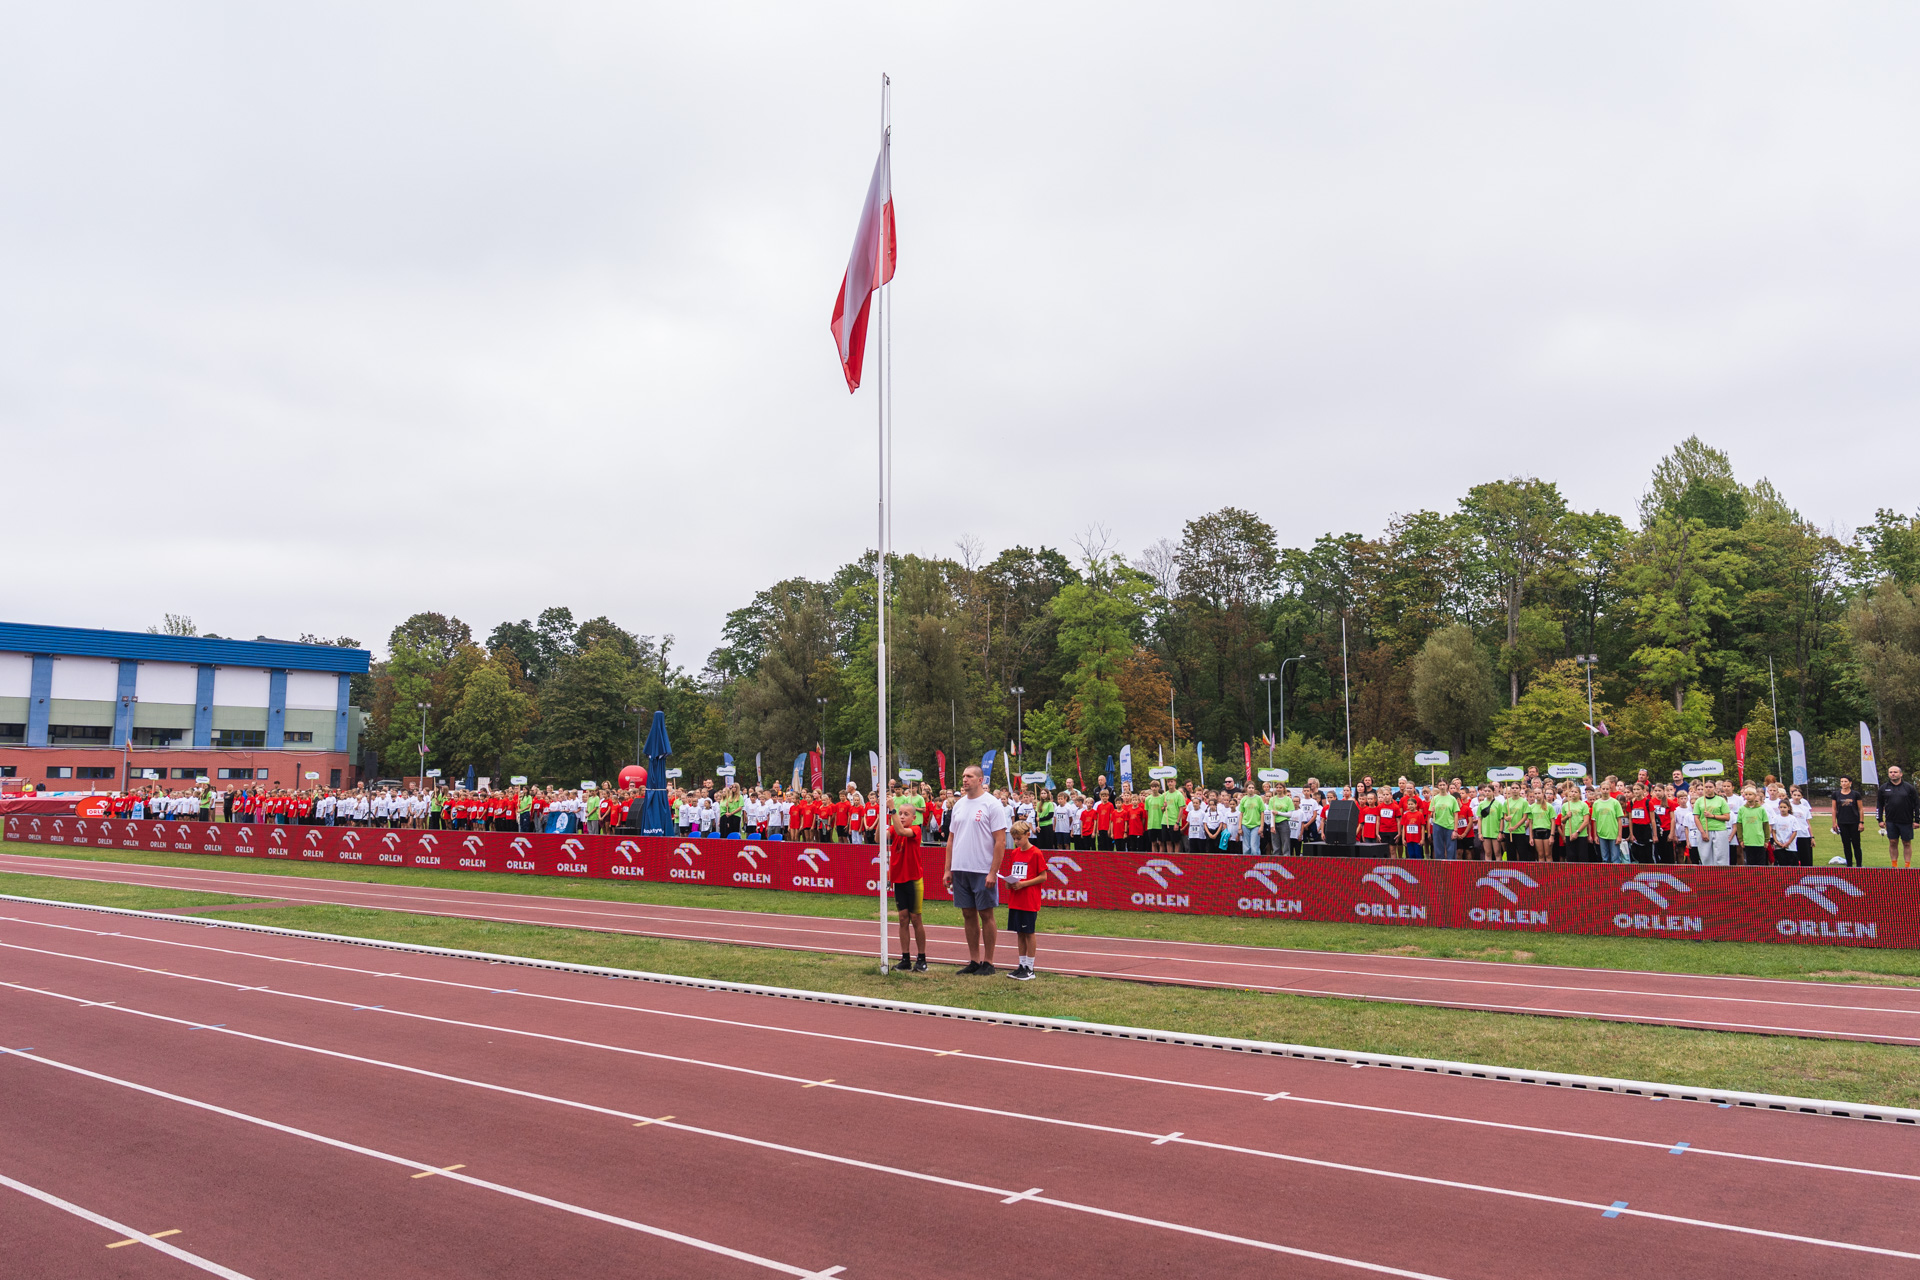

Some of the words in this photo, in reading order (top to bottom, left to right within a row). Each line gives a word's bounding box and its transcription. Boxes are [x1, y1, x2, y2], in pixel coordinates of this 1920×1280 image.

[204, 844, 222, 852] ORLEN
[235, 846, 254, 854] ORLEN
[302, 850, 324, 858] ORLEN
[339, 852, 362, 860] ORLEN
[379, 854, 403, 863] ORLEN
[415, 856, 441, 865] ORLEN
[459, 858, 486, 868] ORLEN
[507, 860, 535, 870] ORLEN
[557, 863, 588, 873] ORLEN
[612, 865, 644, 876] ORLEN
[670, 868, 705, 879] ORLEN
[733, 872, 771, 884] ORLEN
[793, 876, 834, 888] ORLEN
[1131, 892, 1190, 907] ORLEN
[1237, 897, 1302, 913] ORLEN
[1354, 903, 1426, 920] ORLEN
[1468, 907, 1549, 926] ORLEN
[1612, 913, 1702, 932] ORLEN
[1776, 919, 1878, 939] ORLEN
